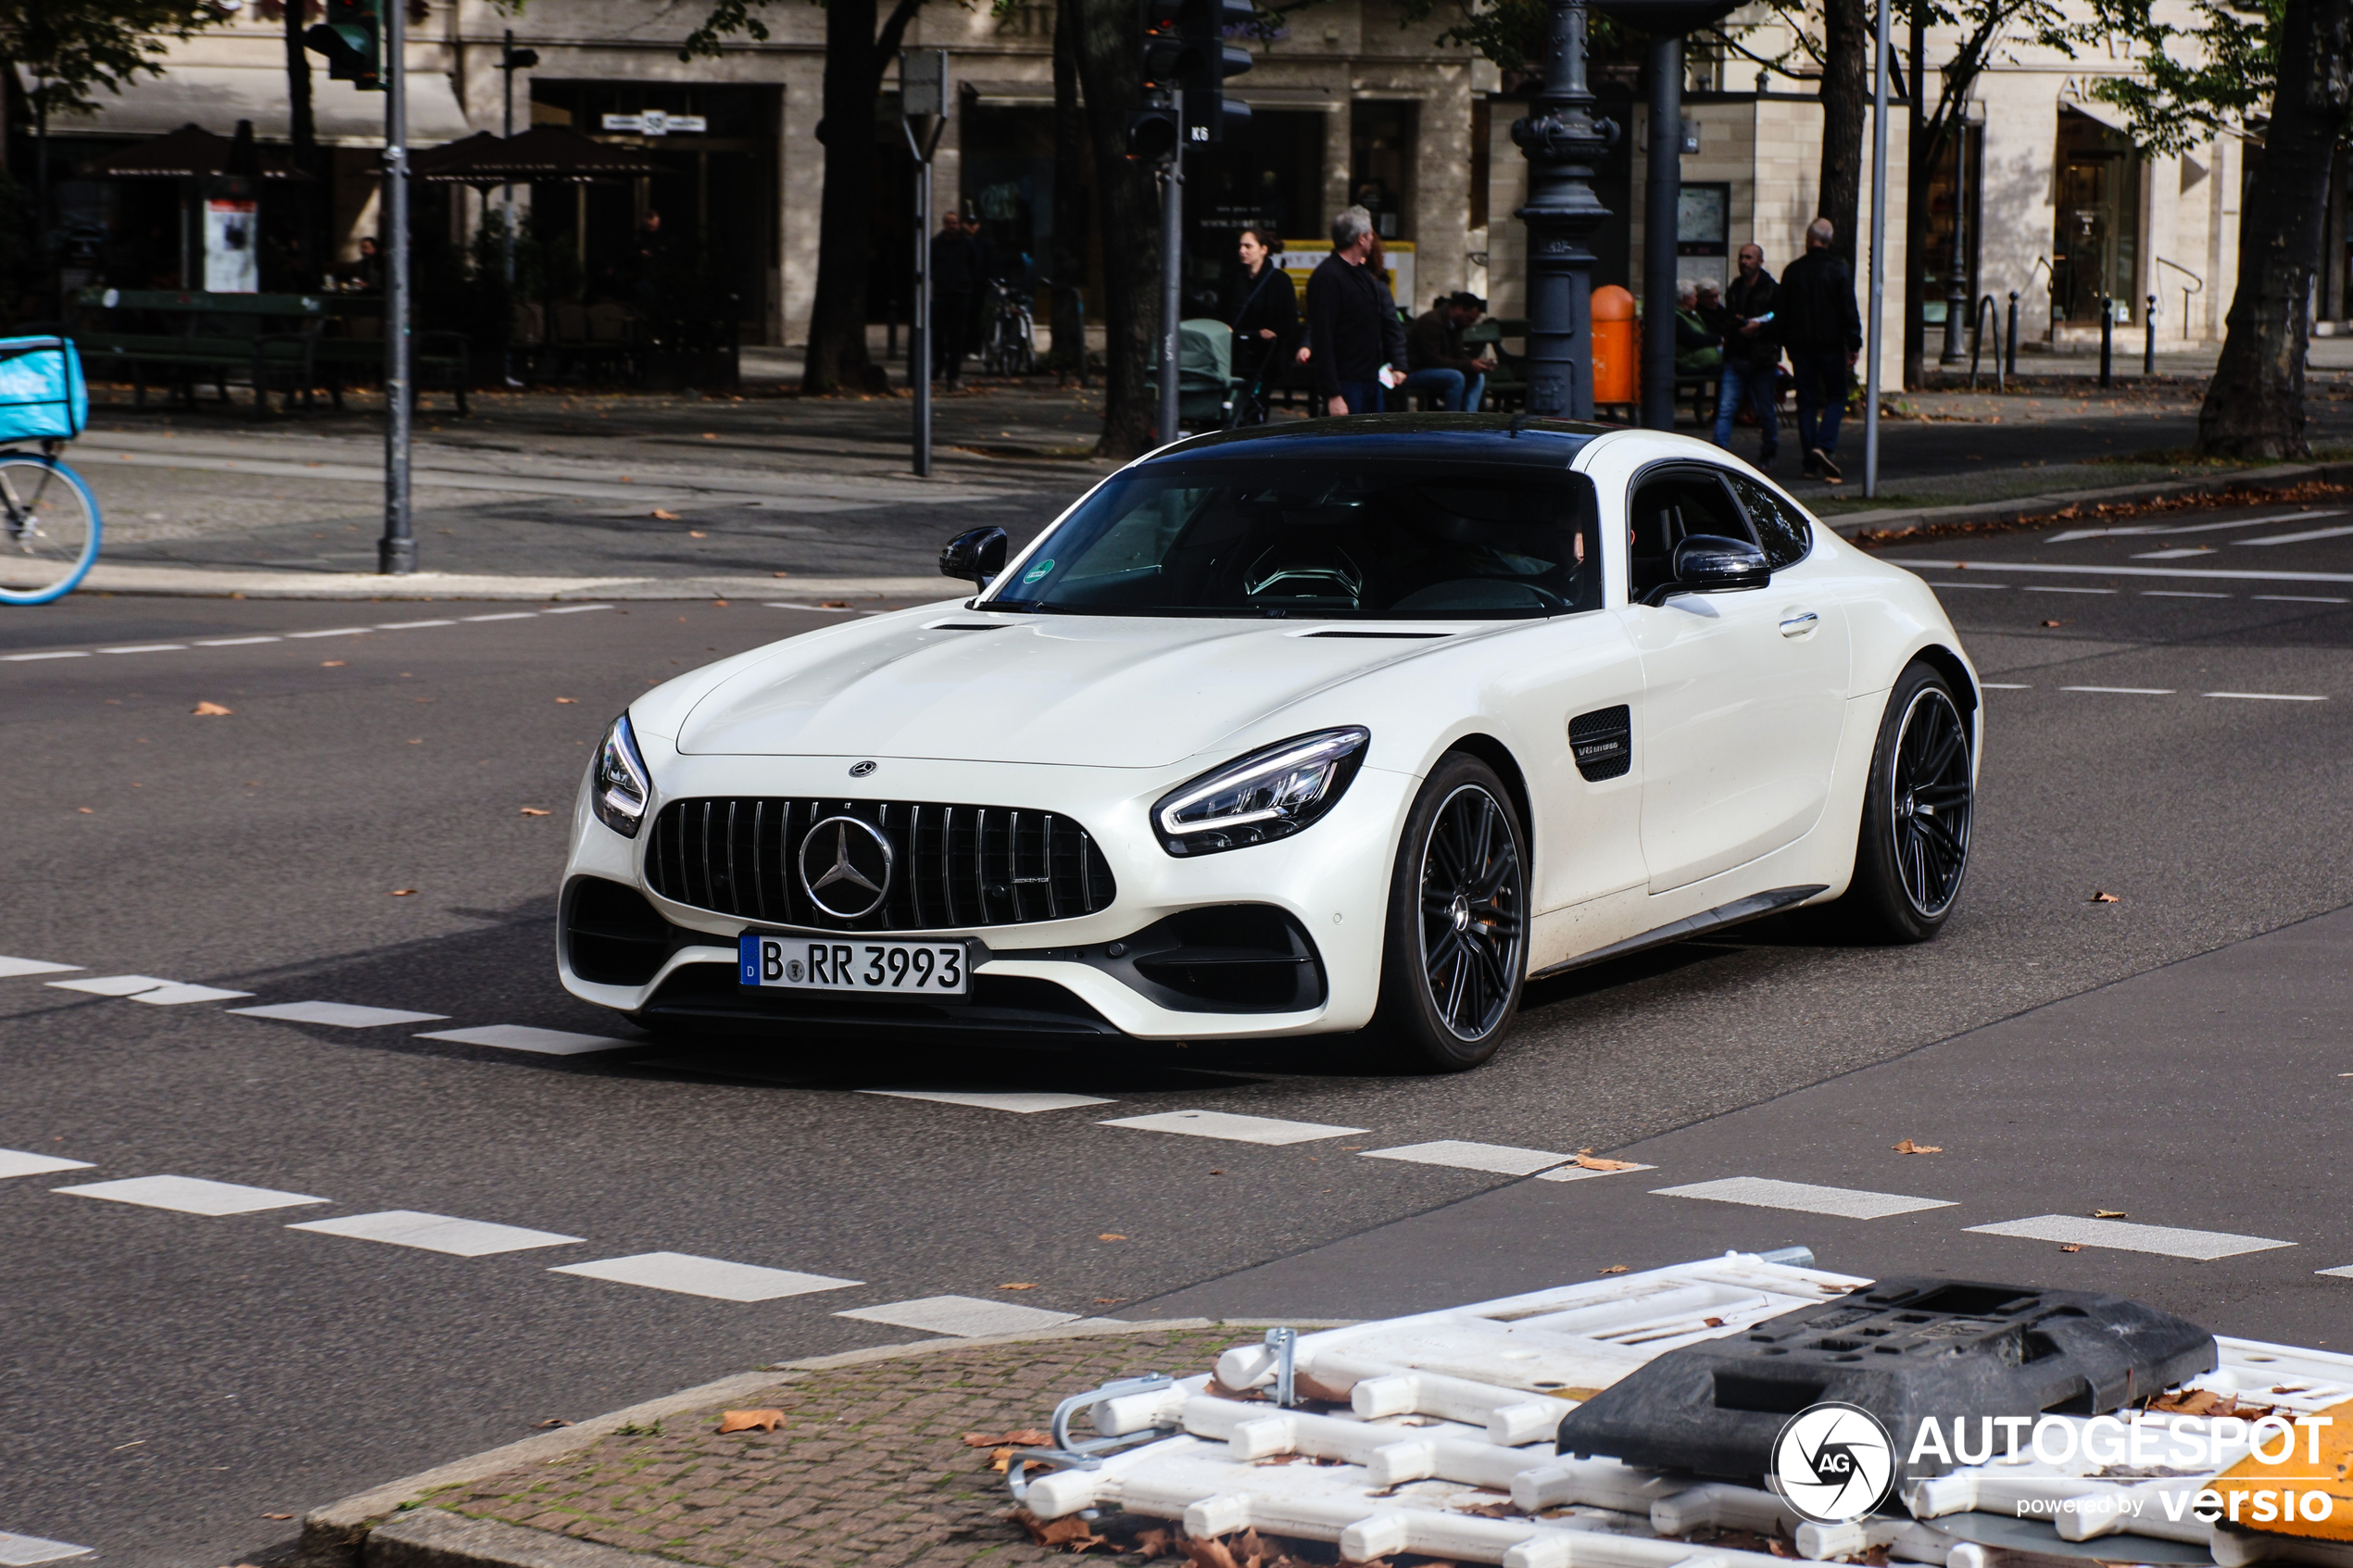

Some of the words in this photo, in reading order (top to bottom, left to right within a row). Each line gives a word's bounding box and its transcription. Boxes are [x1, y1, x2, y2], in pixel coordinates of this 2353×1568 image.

[1191, 126, 1209, 142] K6
[747, 966, 754, 977] D
[762, 941, 784, 980] B
[809, 944, 854, 985] RR
[863, 947, 961, 988] 3993
